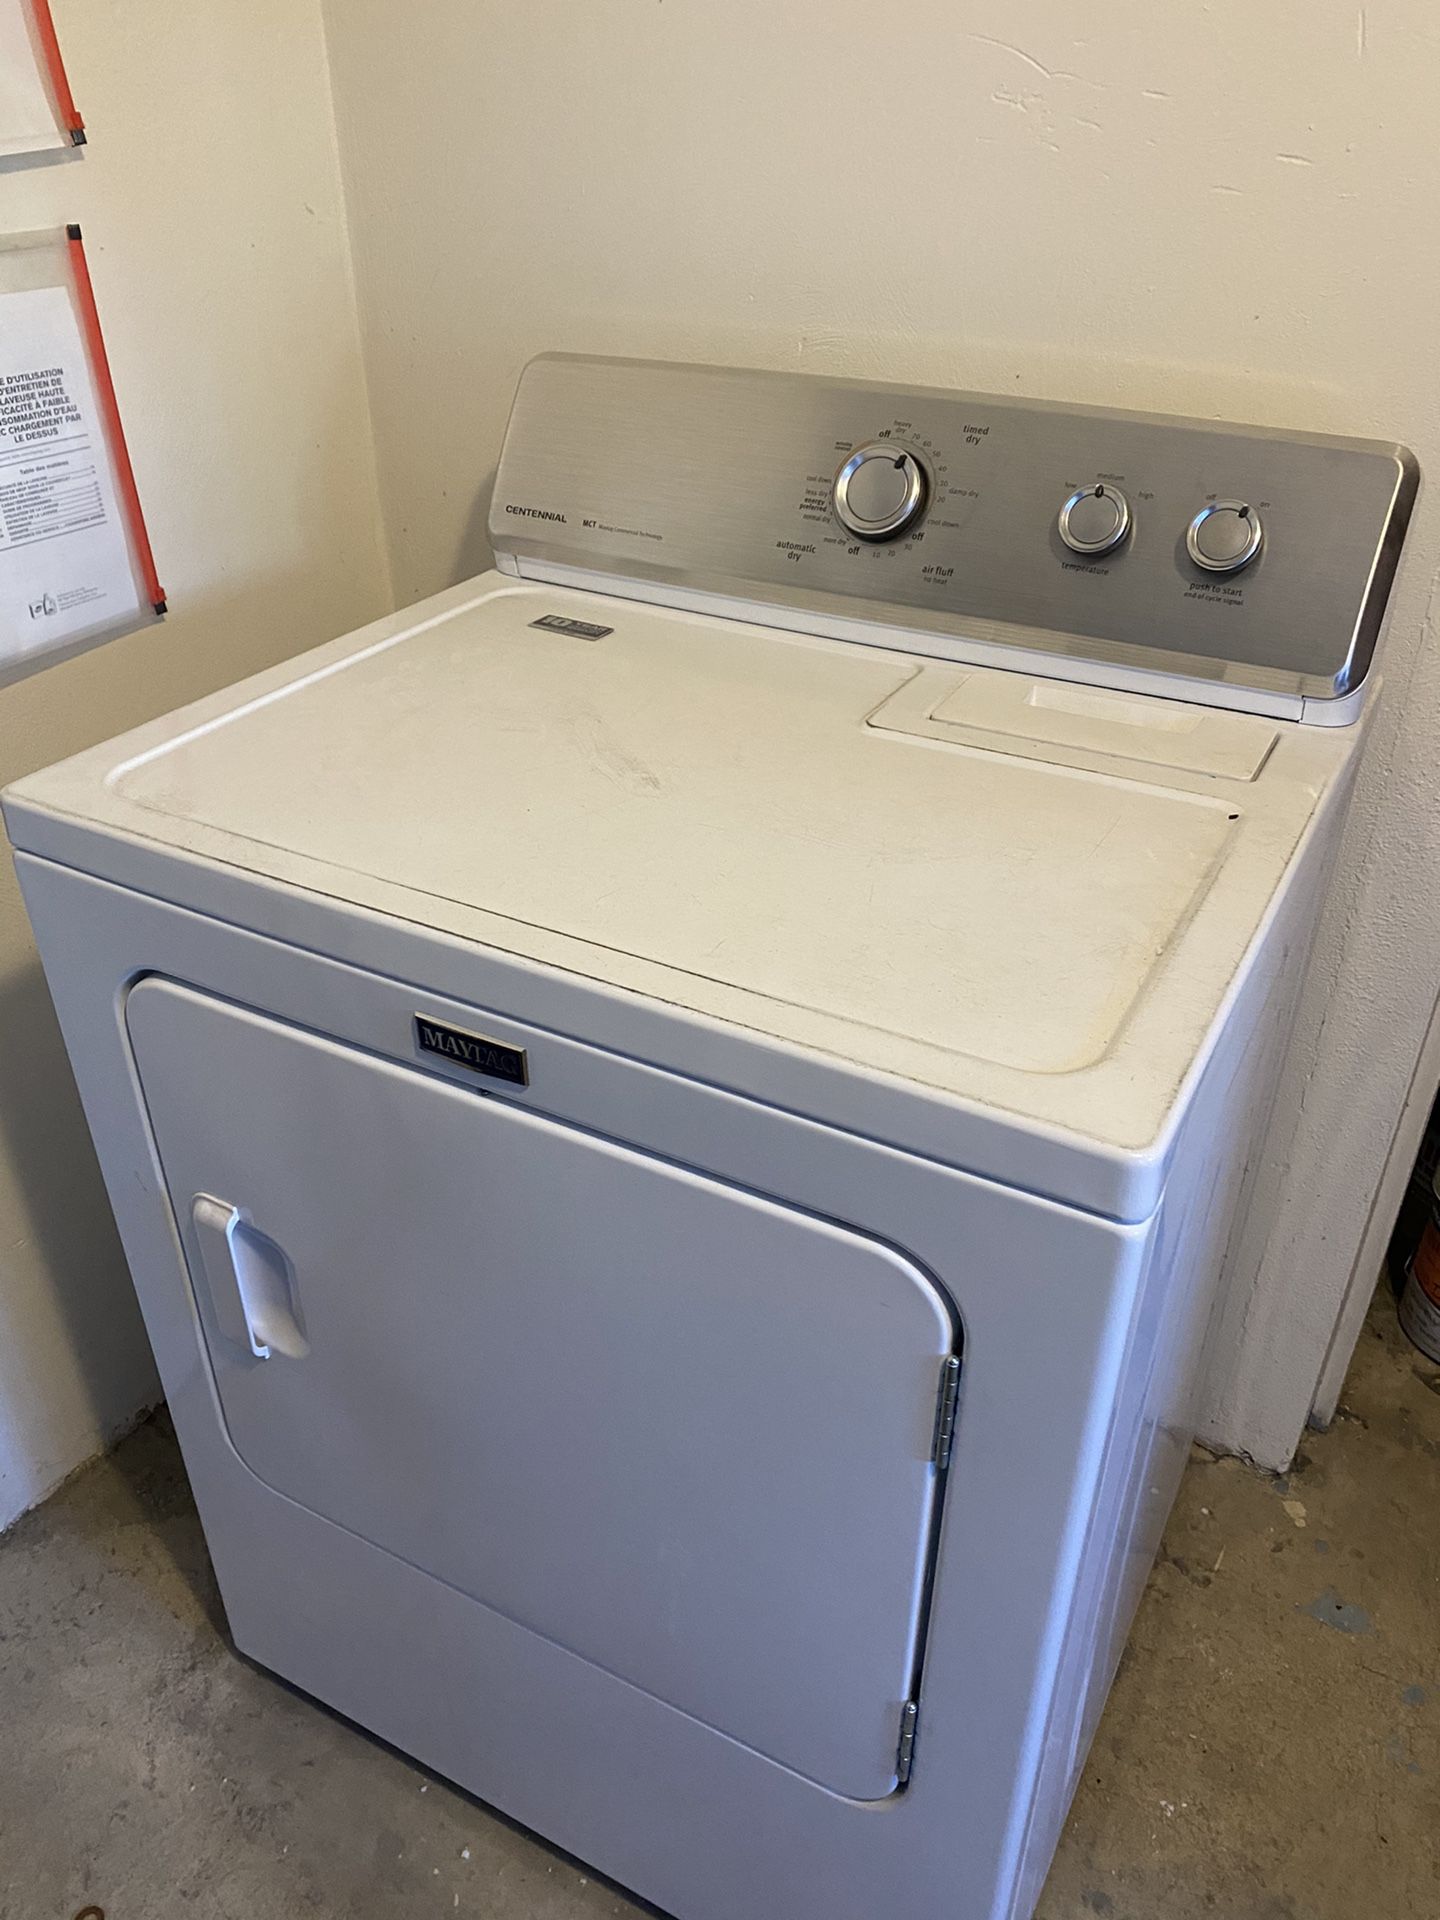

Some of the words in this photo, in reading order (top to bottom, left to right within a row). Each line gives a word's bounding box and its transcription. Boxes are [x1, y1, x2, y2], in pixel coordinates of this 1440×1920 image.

[6, 368, 64, 385] D'UTILISATION
[51, 377, 63, 387] DE
[38, 387, 65, 398] HAUTE
[42, 395, 70, 408] FAIBLE
[53, 404, 77, 416] D'EAU
[8, 416, 63, 434] CHARGEMENT
[65, 413, 82, 423] PAR
[14, 435, 25, 443] LE
[25, 427, 59, 440] DESSUS
[878, 429, 892, 438] off
[963, 424, 990, 436] timed
[966, 434, 981, 446] dry
[799, 503, 828, 512] preferred
[804, 497, 825, 506] energy
[505, 504, 567, 524] CENTENNIAL
[582, 519, 597, 528] MCT
[911, 532, 925, 541] off
[776, 540, 816, 554] automatic
[847, 545, 861, 555] off
[787, 551, 801, 562] dry
[921, 565, 934, 575] air
[935, 566, 954, 577] fluff
[1061, 562, 1110, 576] temperature
[1189, 583, 1210, 592] push
[1211, 585, 1221, 594] to
[1222, 588, 1243, 597] start
[422, 1026, 519, 1076] MAYTAG
